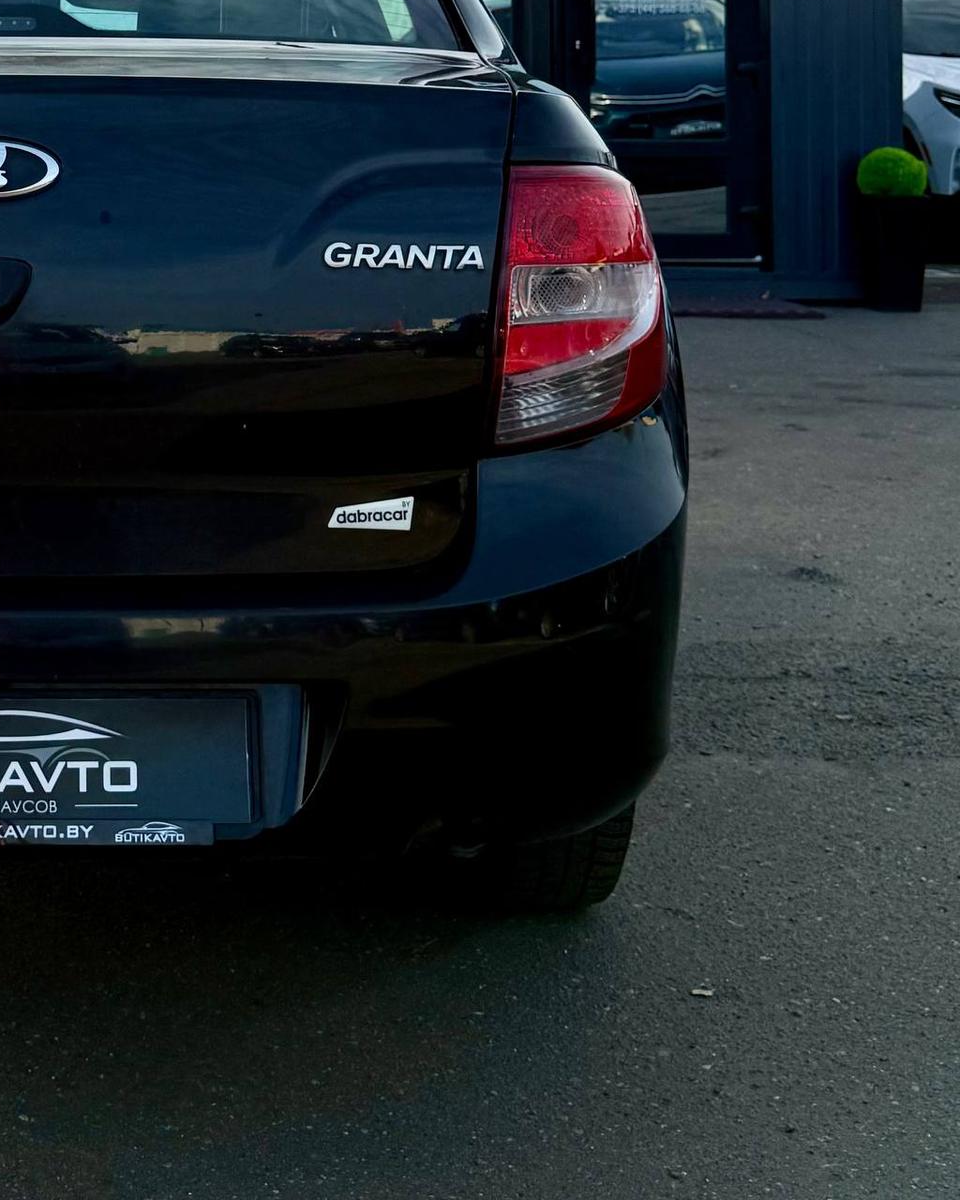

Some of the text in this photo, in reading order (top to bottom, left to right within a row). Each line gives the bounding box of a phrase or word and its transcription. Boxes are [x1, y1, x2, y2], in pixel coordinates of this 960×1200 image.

[323, 242, 485, 270] GRANTA
[336, 509, 409, 524] dabracar
[114, 832, 186, 843] BUTIKAVTO
